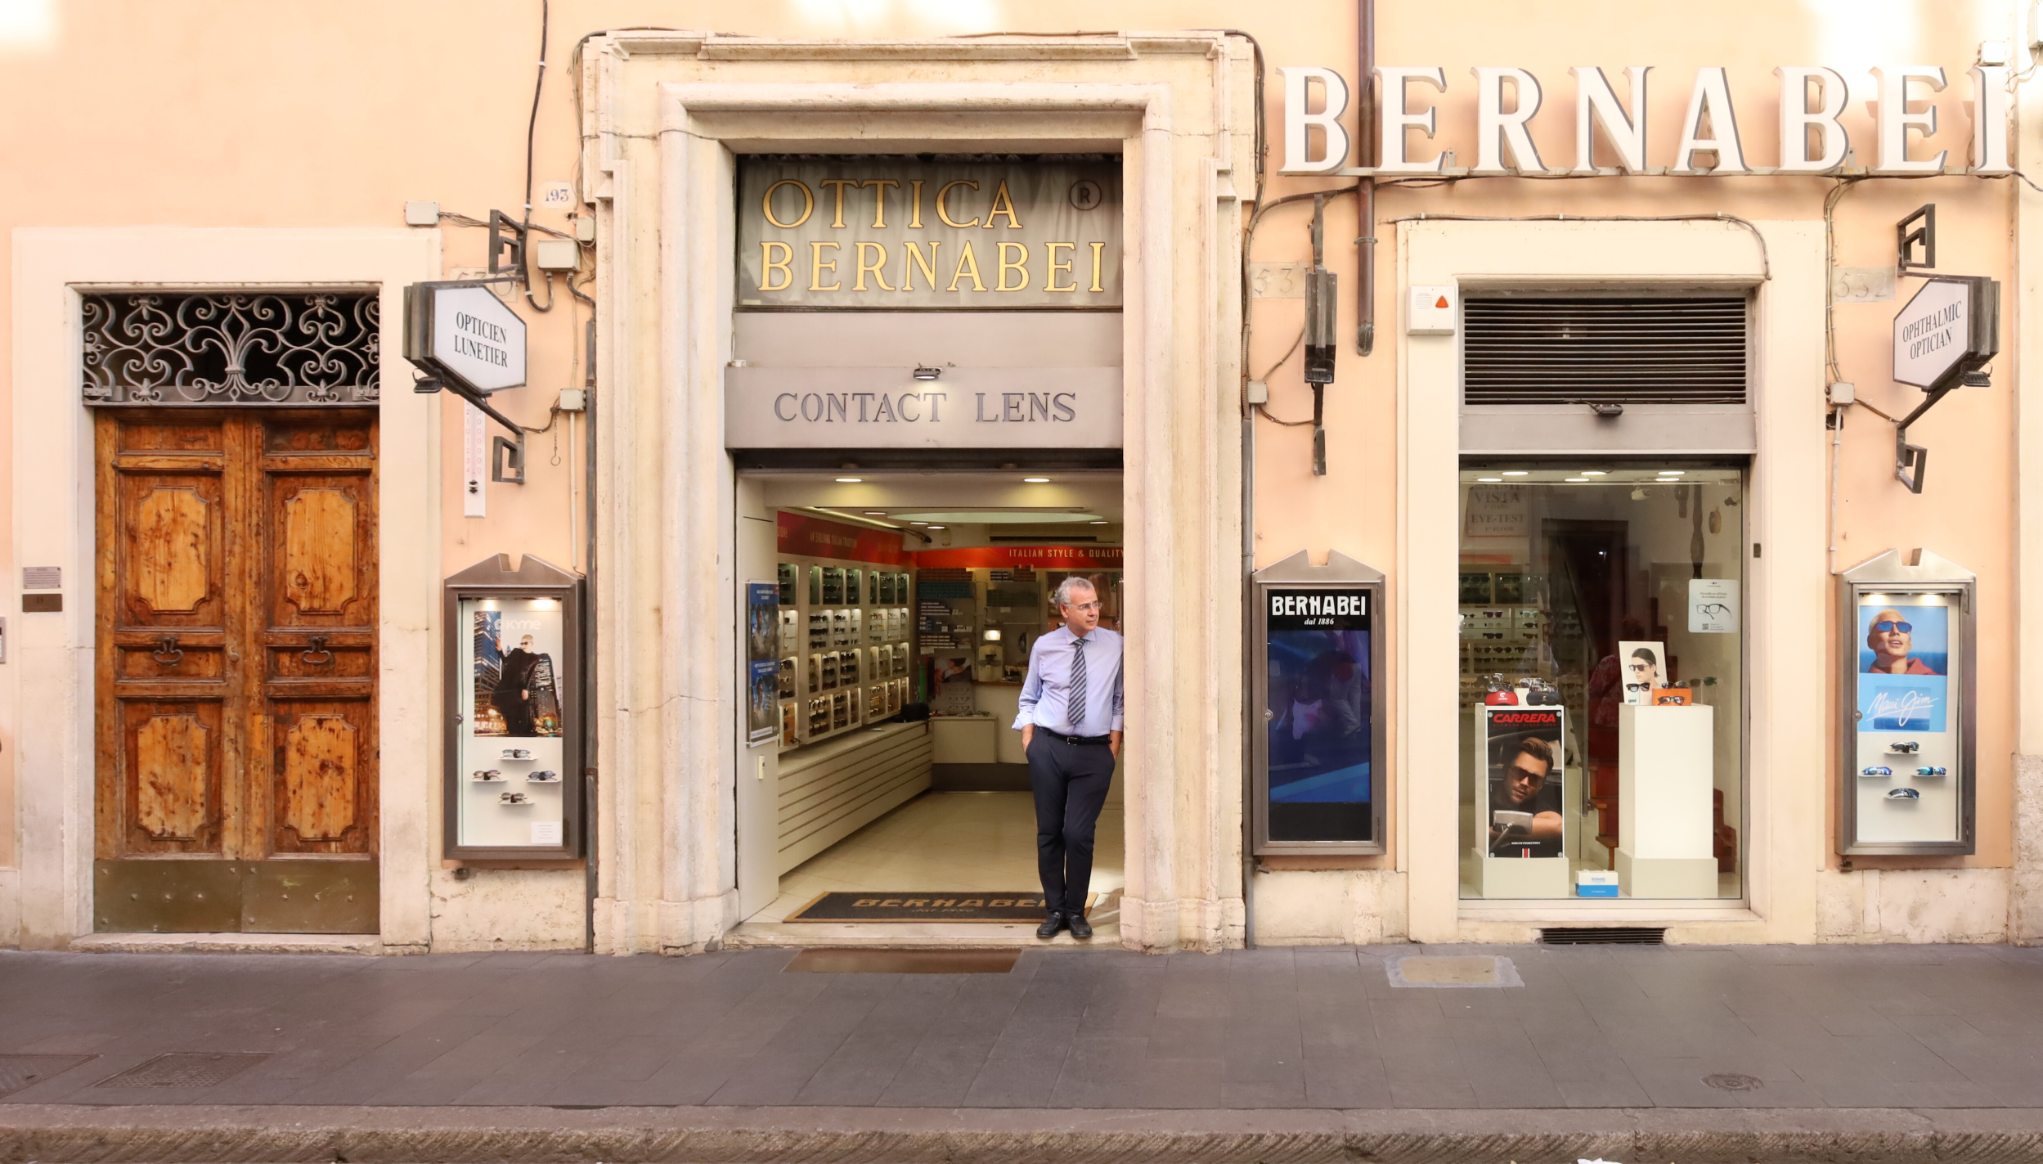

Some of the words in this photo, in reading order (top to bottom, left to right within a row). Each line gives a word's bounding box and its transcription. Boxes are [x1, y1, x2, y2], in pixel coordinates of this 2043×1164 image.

[1275, 66, 2015, 173] BERNABEI
[762, 178, 1023, 229] OTTICA
[758, 240, 1105, 292] BERNABEI
[456, 311, 508, 344] OPTICIEN
[1902, 301, 1962, 343] OPHTHALMIC
[454, 334, 508, 368] LUNETIER
[1910, 326, 1953, 360] OPTICIAN
[774, 392, 947, 423] CONTACT
[975, 392, 1077, 423] LENS
[1009, 549, 1043, 558] ITALIAN
[1048, 549, 1073, 558] STYLE
[1078, 549, 1085, 558] &
[1272, 596, 1366, 616] BERNABEI
[1304, 618, 1317, 626] dal
[1493, 713, 1556, 724] CARRERA
